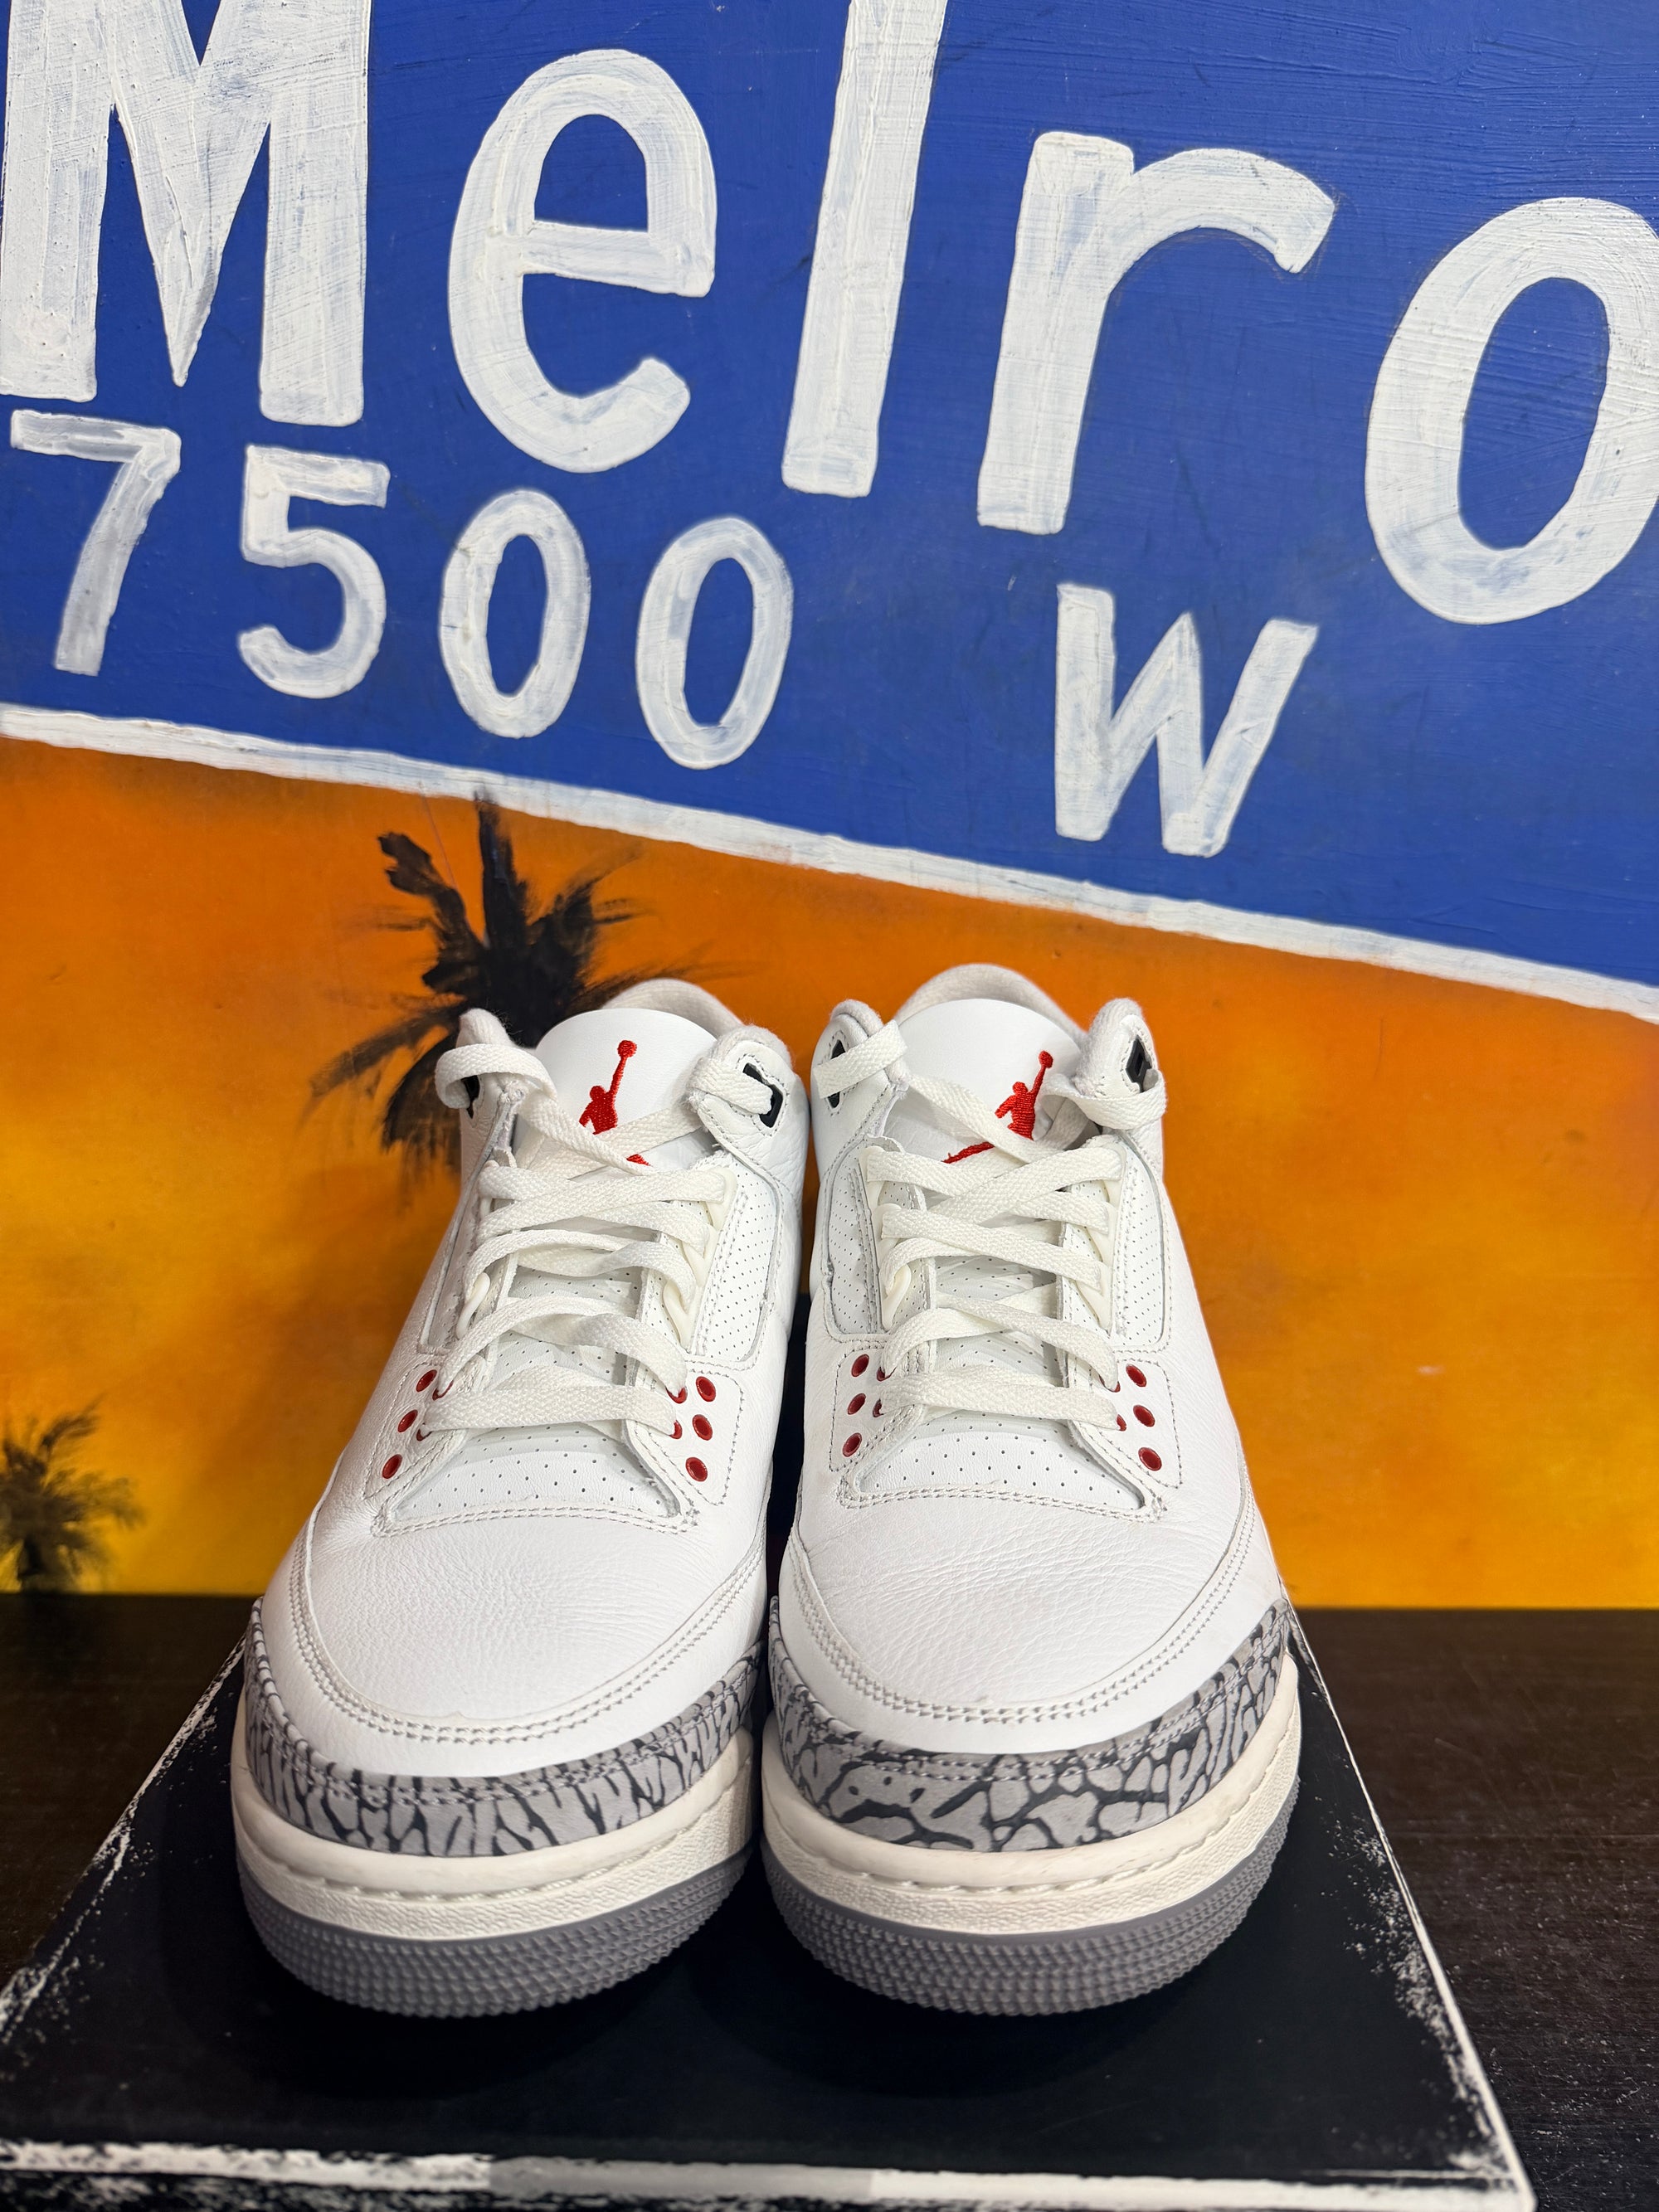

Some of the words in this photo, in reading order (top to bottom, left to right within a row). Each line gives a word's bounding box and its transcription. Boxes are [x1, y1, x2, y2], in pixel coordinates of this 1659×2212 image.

[0, 0, 1659, 625] Melro
[10, 409, 794, 770] 7500
[1054, 581, 1319, 858] W
